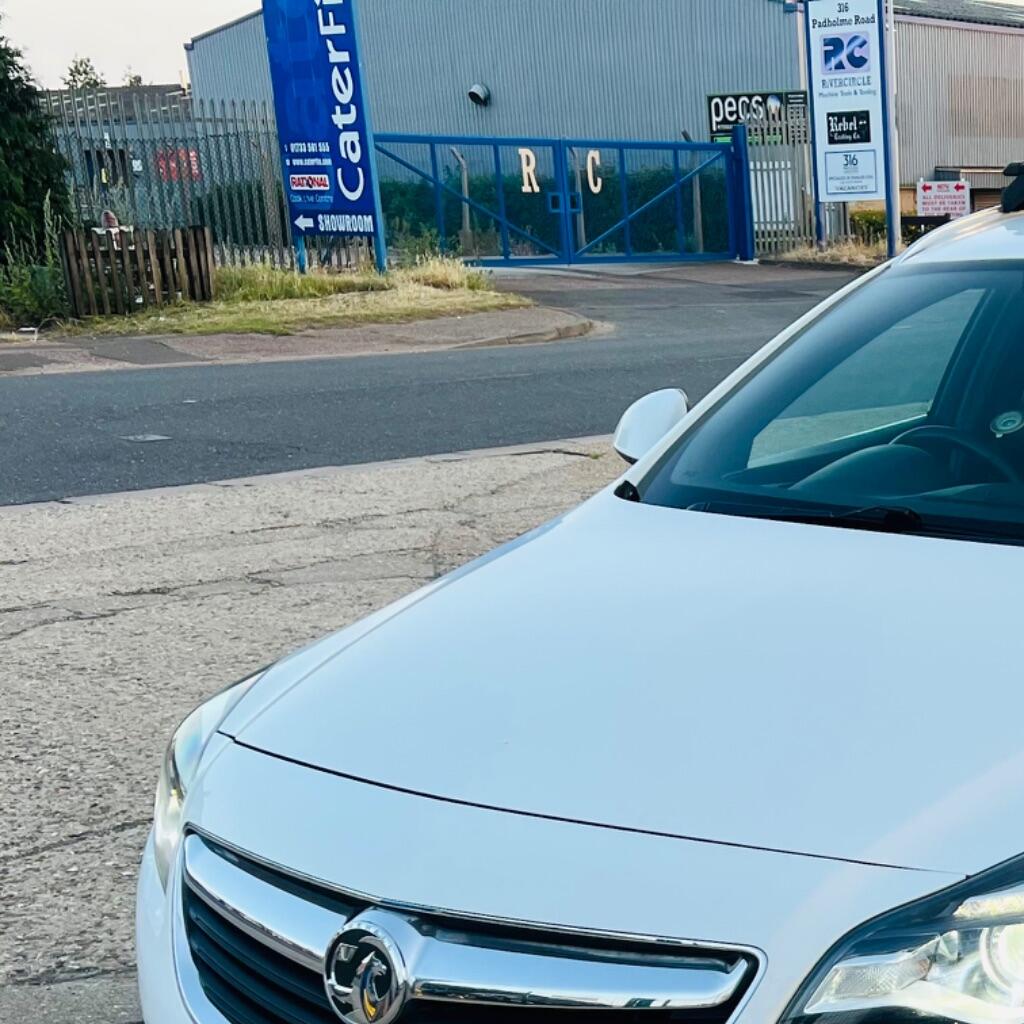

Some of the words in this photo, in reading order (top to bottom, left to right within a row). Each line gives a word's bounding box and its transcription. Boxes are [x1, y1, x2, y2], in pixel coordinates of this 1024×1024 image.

[811, 16, 853, 29] Padholme
[854, 14, 876, 25] Road
[711, 95, 764, 132] pecs
[828, 116, 857, 132] Rebel
[843, 154, 858, 166] 316
[518, 148, 540, 193] R
[587, 149, 603, 194] C
[290, 175, 329, 189] RATIONAL
[318, 213, 374, 233] SHOWROOM
